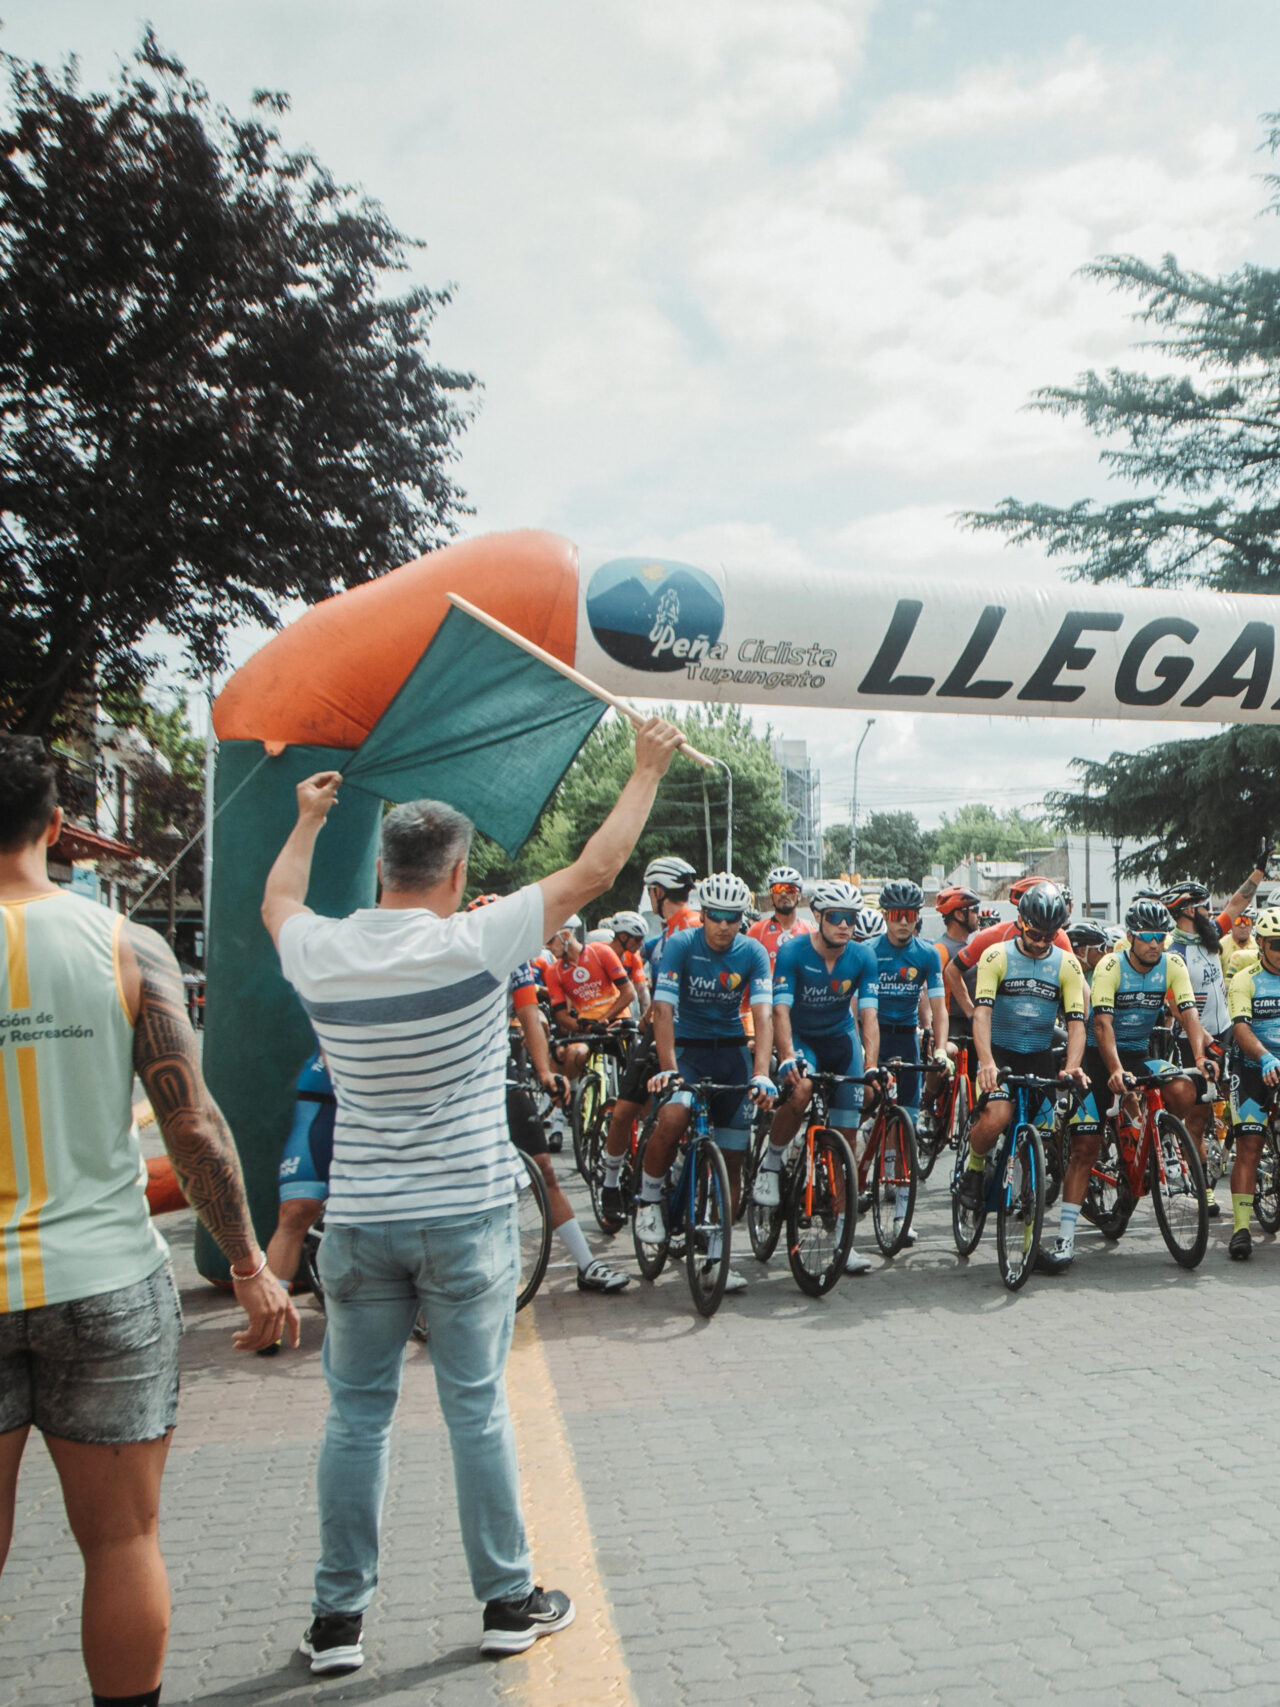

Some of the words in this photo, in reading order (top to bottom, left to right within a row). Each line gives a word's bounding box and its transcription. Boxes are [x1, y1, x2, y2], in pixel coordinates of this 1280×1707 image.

[652, 625, 728, 661] Peña
[738, 639, 837, 669] Ciclista
[685, 661, 826, 690] Tupungato
[689, 976, 717, 990] Viví
[879, 981, 919, 992] unuyán
[803, 985, 828, 996] Viví
[36, 1012, 54, 1025] de
[10, 1025, 94, 1042] Recreación
